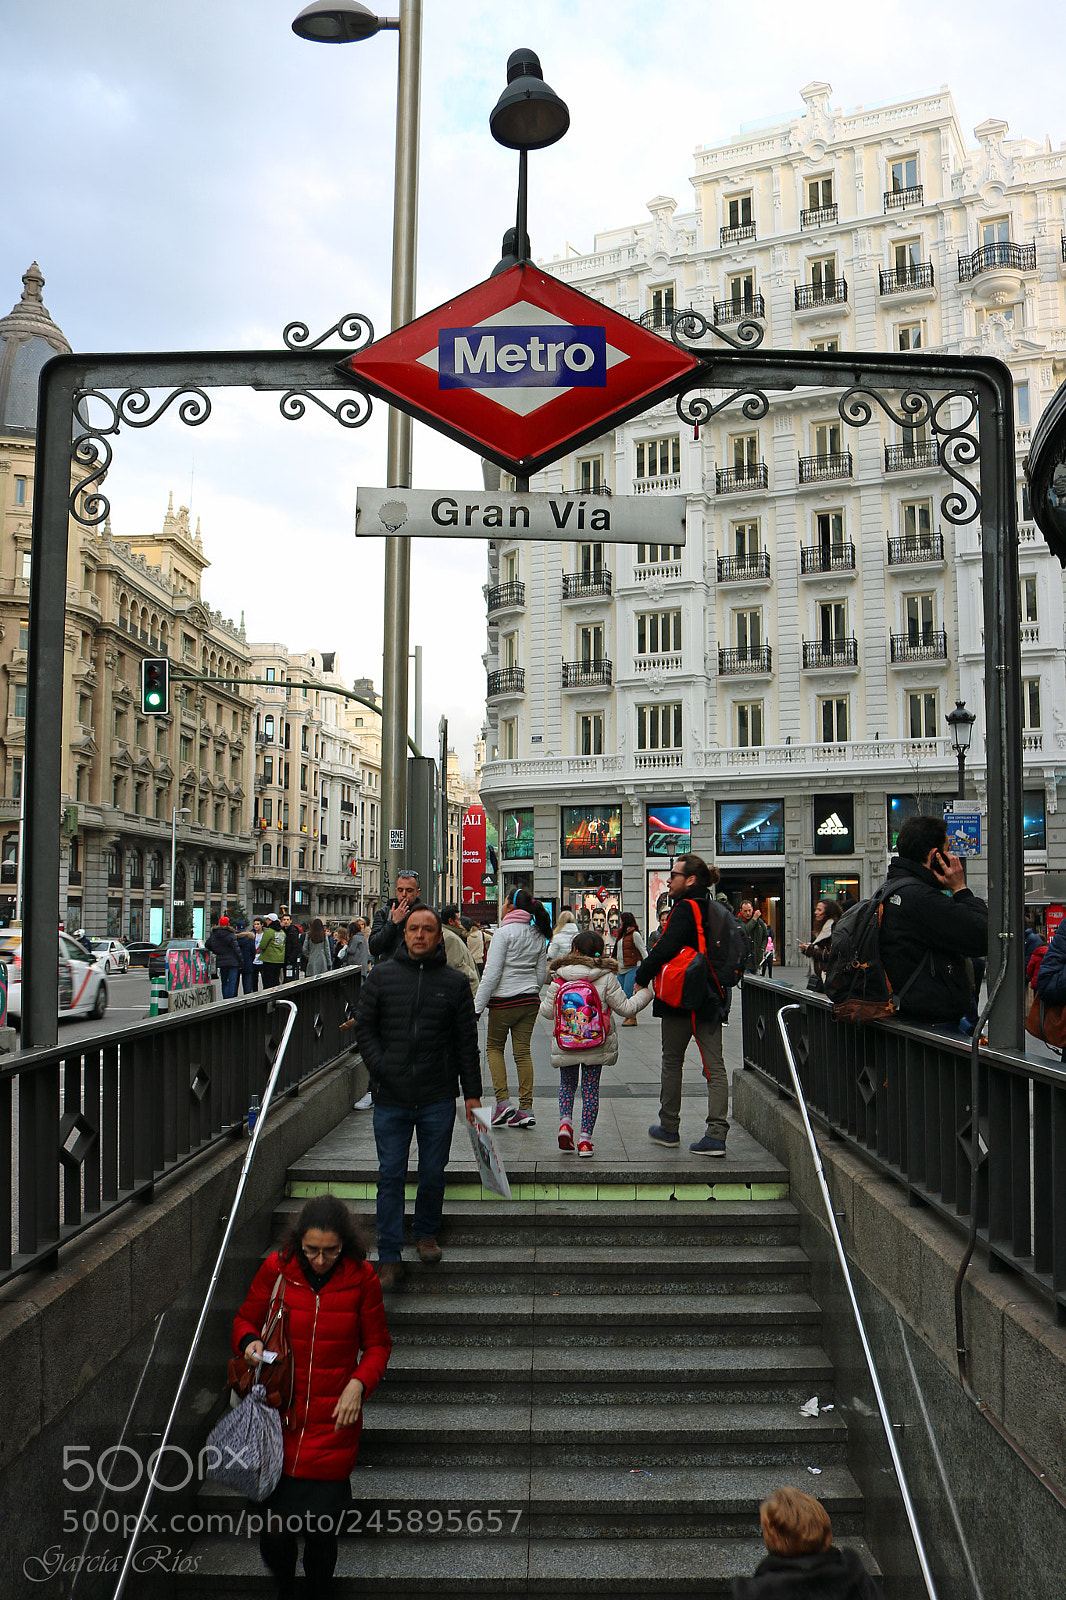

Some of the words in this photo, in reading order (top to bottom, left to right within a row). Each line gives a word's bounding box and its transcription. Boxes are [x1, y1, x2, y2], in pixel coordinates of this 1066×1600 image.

[454, 335, 595, 374] Metro
[431, 497, 530, 527] Gran
[549, 500, 611, 531] Vía
[463, 814, 482, 826] ALI
[390, 830, 403, 838] BNE
[817, 826, 848, 835] adidas
